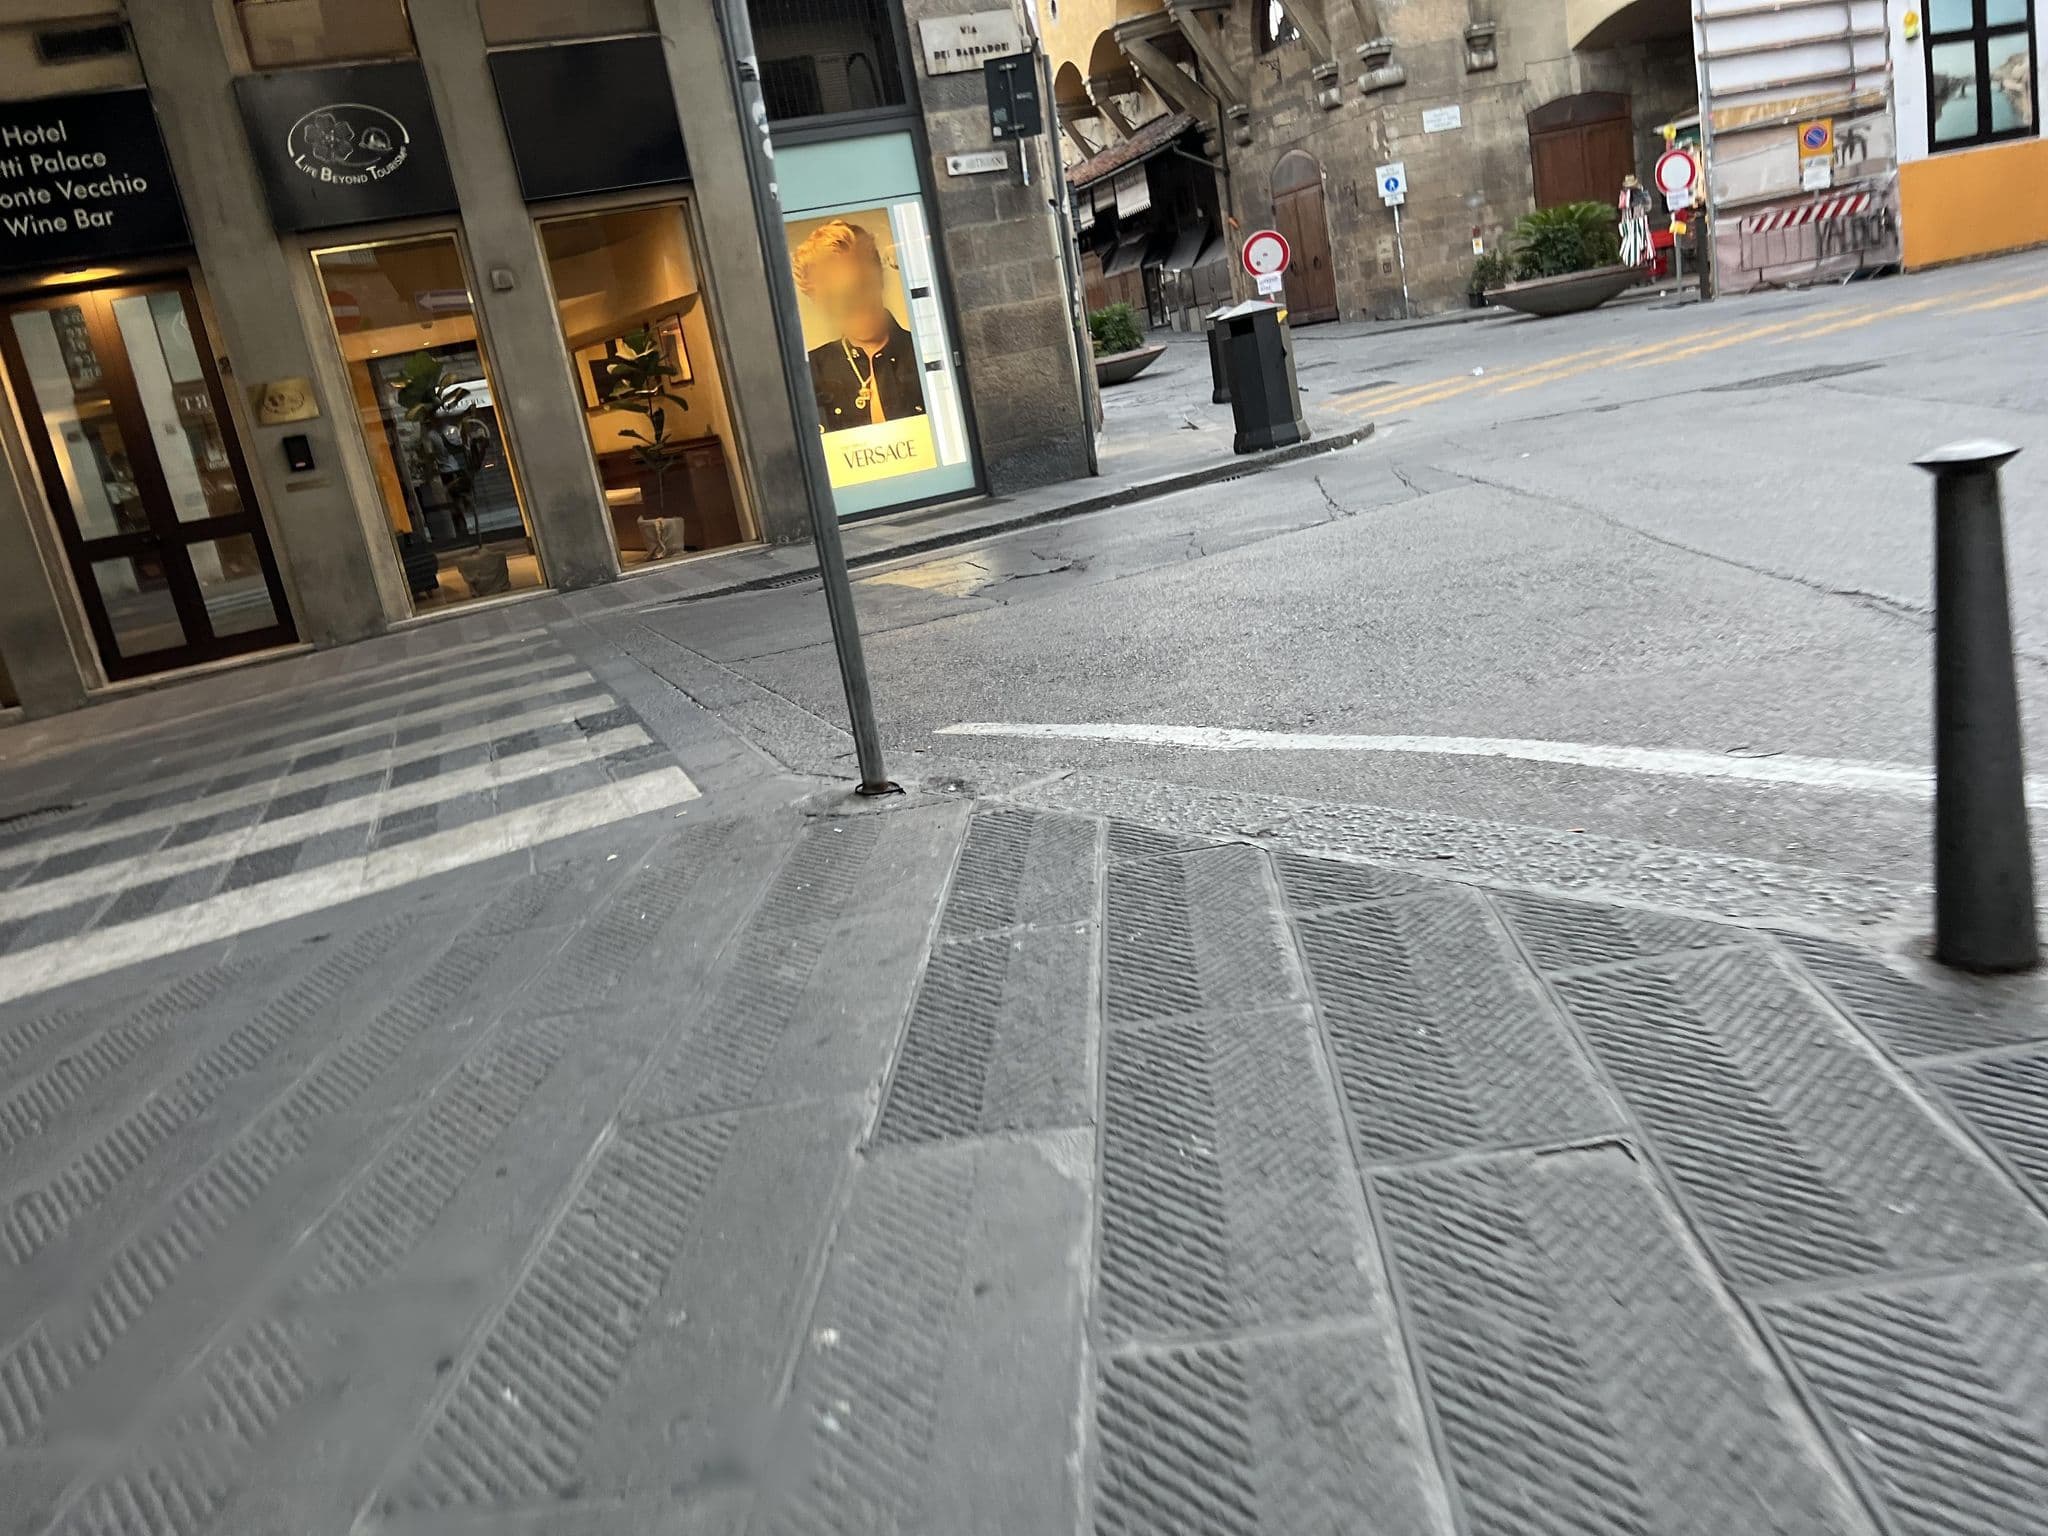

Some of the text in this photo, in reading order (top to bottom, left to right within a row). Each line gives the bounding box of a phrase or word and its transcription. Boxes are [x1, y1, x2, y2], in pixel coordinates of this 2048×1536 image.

[960, 26, 977, 34] VIA
[2, 120, 67, 147] Hotel
[30, 150, 107, 174] Palace
[320, 166, 368, 184] BEYOND
[55, 173, 148, 200] Vecchio
[3, 208, 114, 237] Wine Bar
[843, 440, 918, 469] VERSACE
